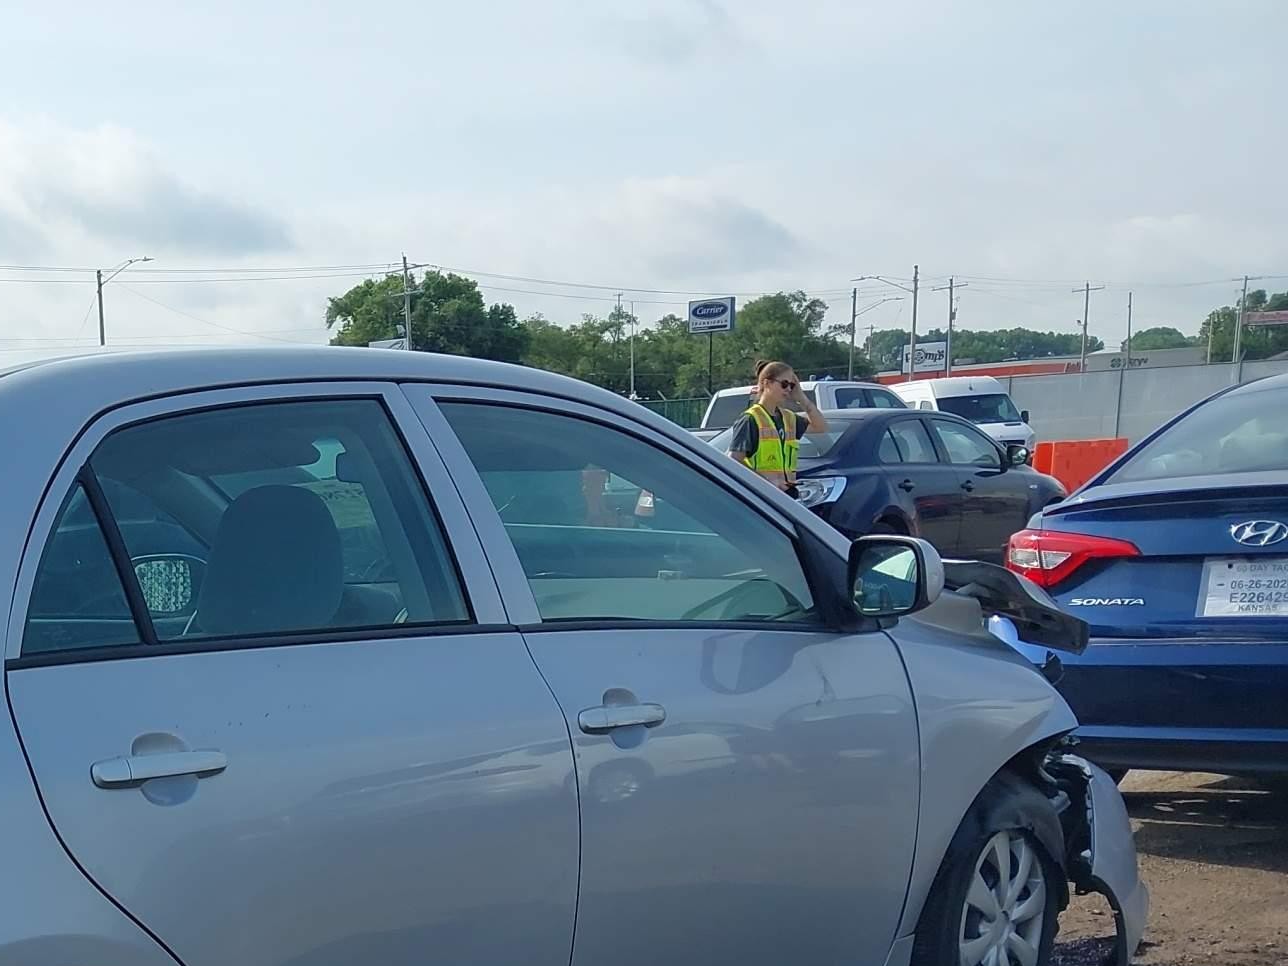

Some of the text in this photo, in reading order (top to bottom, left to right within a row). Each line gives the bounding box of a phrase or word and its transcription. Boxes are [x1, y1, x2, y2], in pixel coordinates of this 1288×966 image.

[696, 305, 725, 316] Carrier
[1250, 564, 1268, 572] DAY
[1230, 579, 1288, 589] 06-26-202
[1068, 598, 1145, 606] SONATA
[1238, 604, 1279, 612] KANSAS
